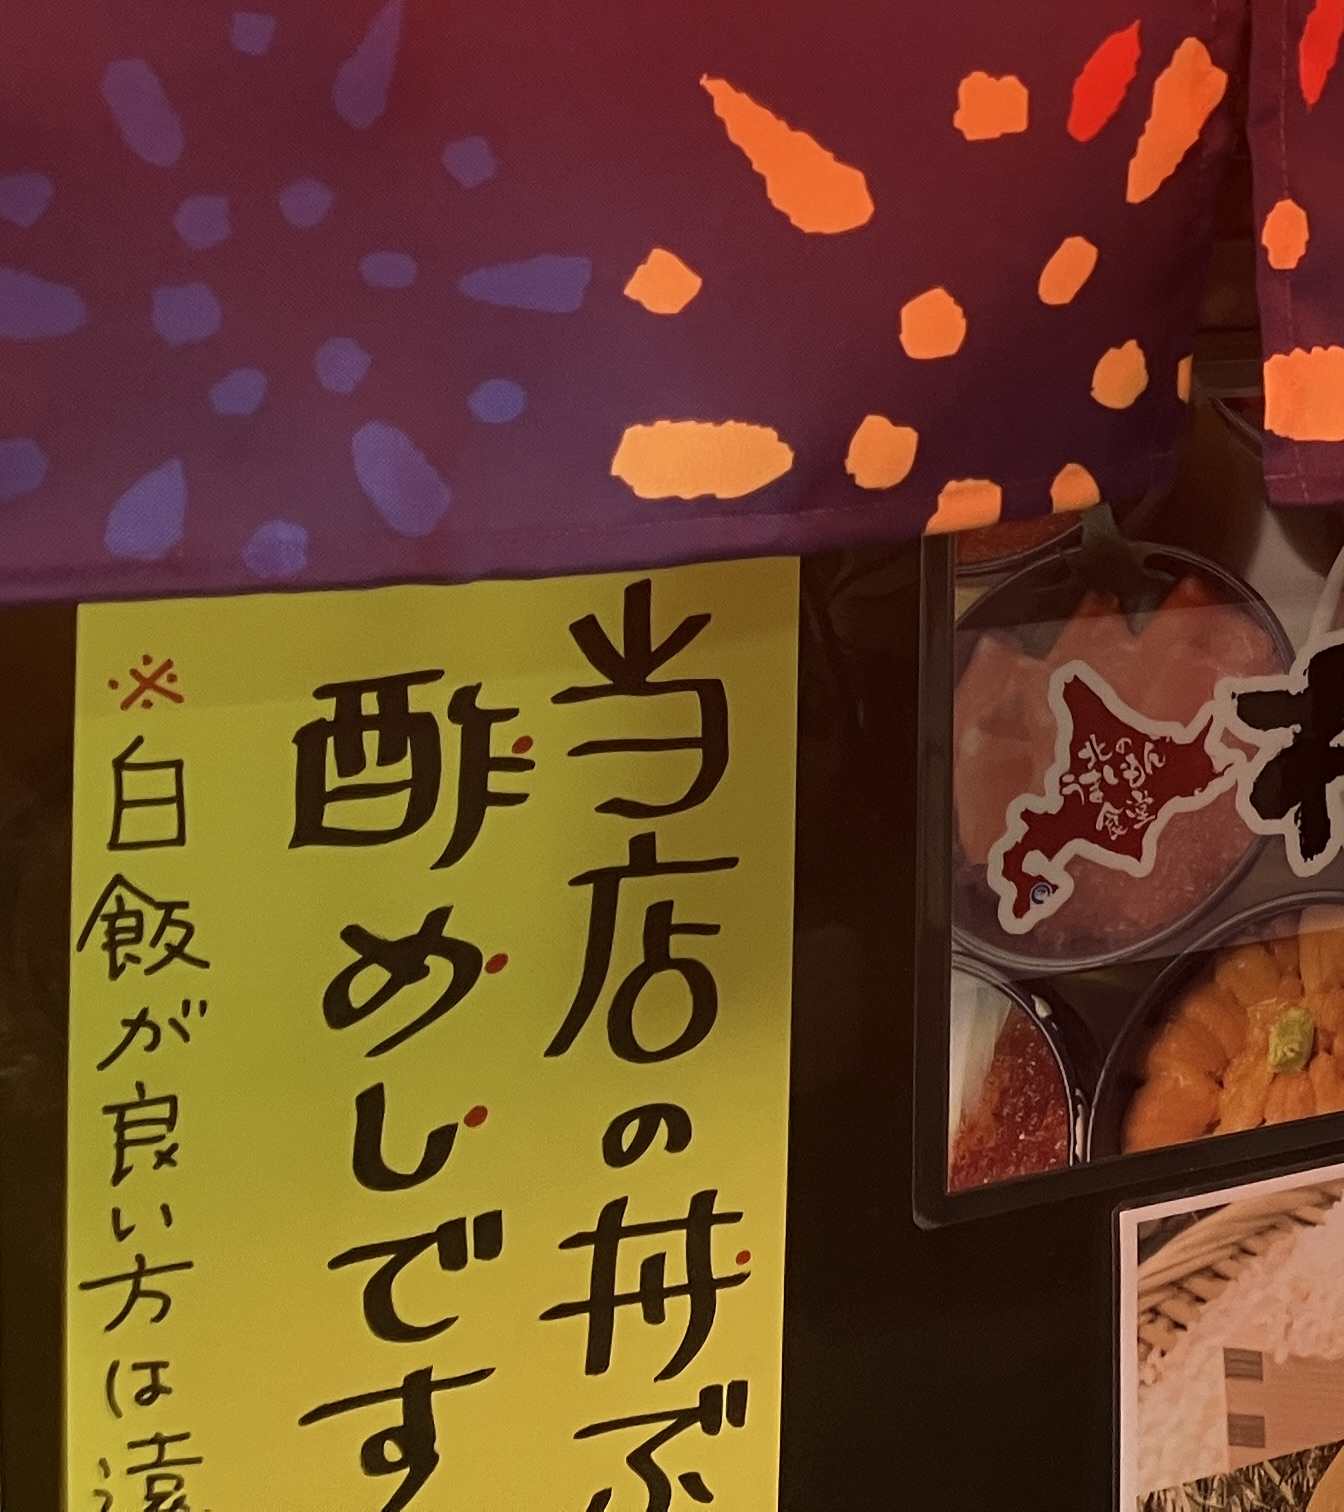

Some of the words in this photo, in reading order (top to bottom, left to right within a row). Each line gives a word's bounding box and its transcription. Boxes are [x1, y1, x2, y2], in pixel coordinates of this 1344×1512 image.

[1077, 733, 1133, 770] 北の
[1096, 790, 1156, 841] 食堂
[288, 669, 536, 1512] 酢めしです
